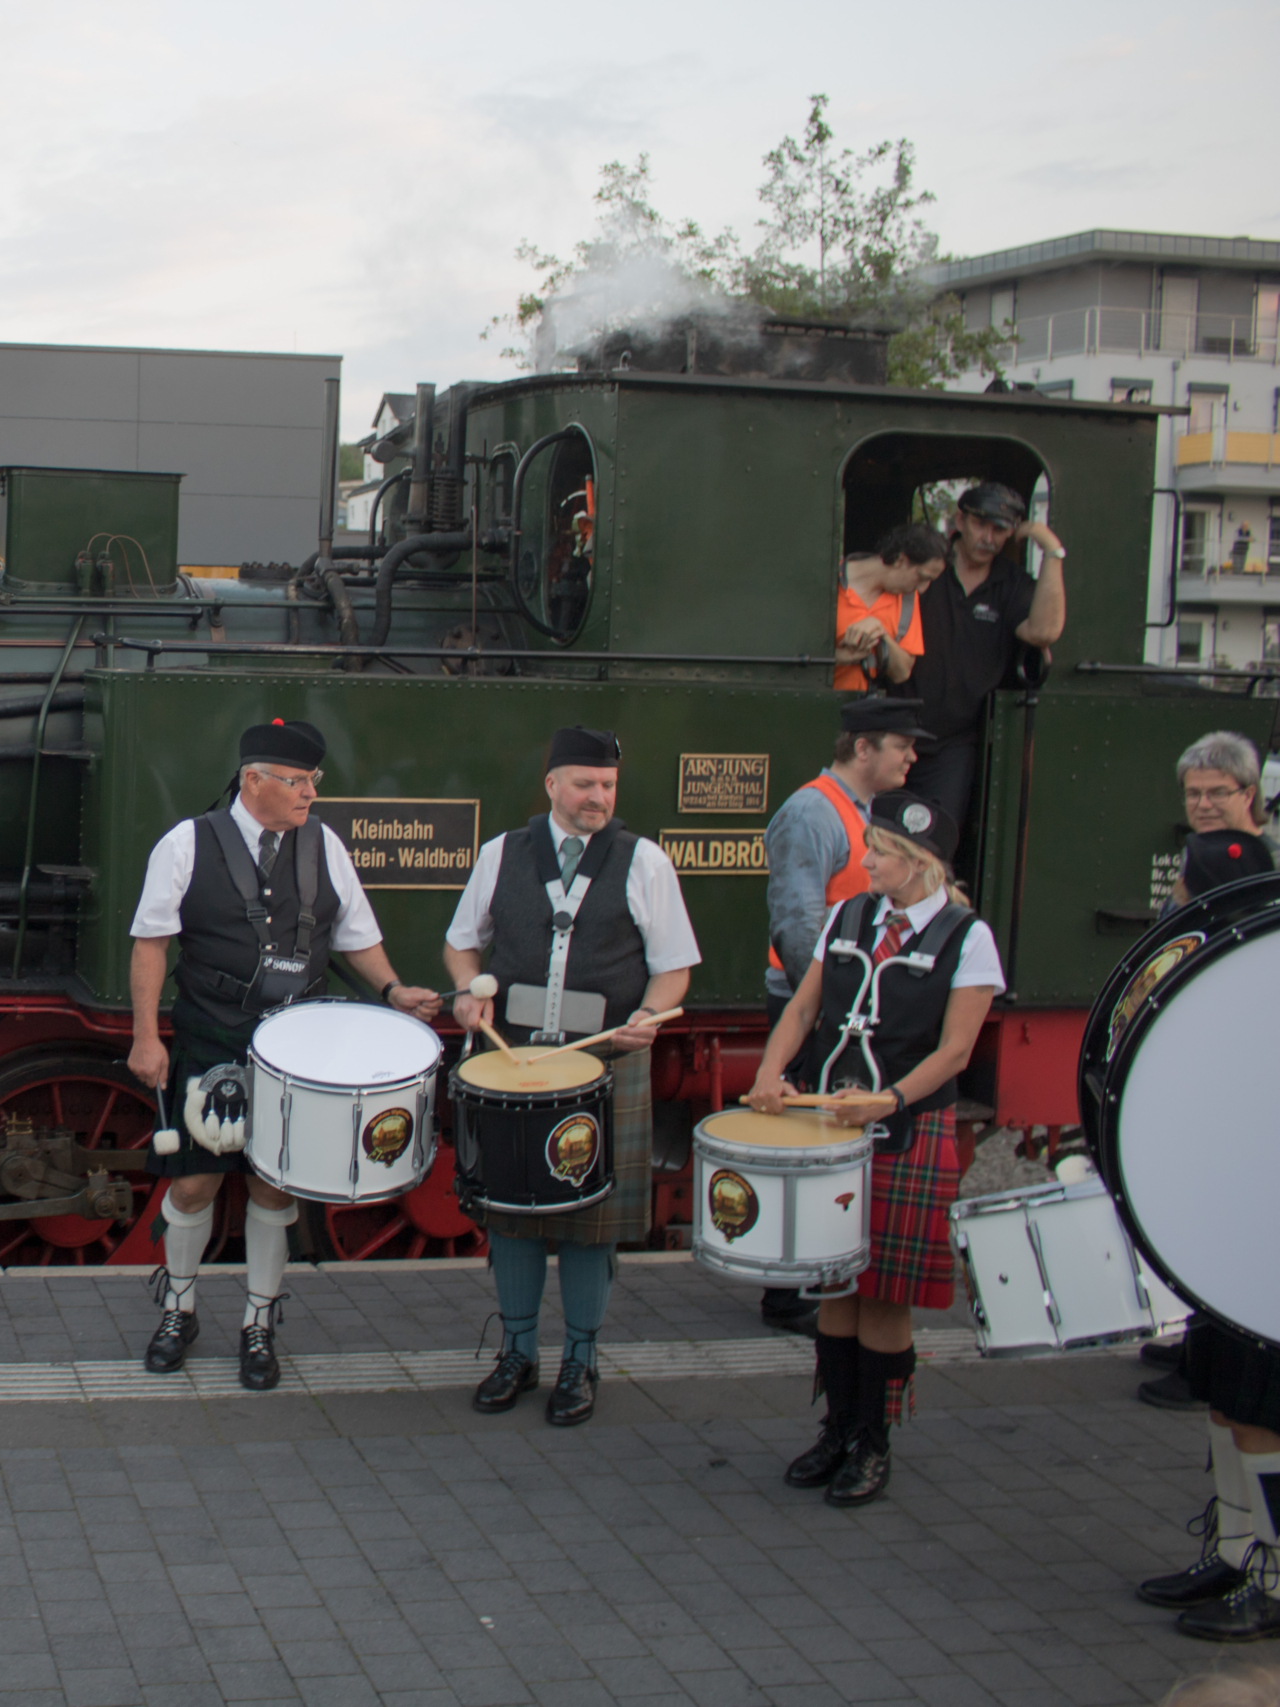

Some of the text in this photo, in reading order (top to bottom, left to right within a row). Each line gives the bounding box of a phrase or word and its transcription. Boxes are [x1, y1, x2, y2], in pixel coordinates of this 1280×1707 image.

[683, 781, 762, 795] JUNGENTHAL
[351, 818, 434, 840] Kleinbahn
[348, 846, 386, 868] tein
[398, 846, 472, 869] Waldbröl
[1152, 853, 1171, 866] Lok
